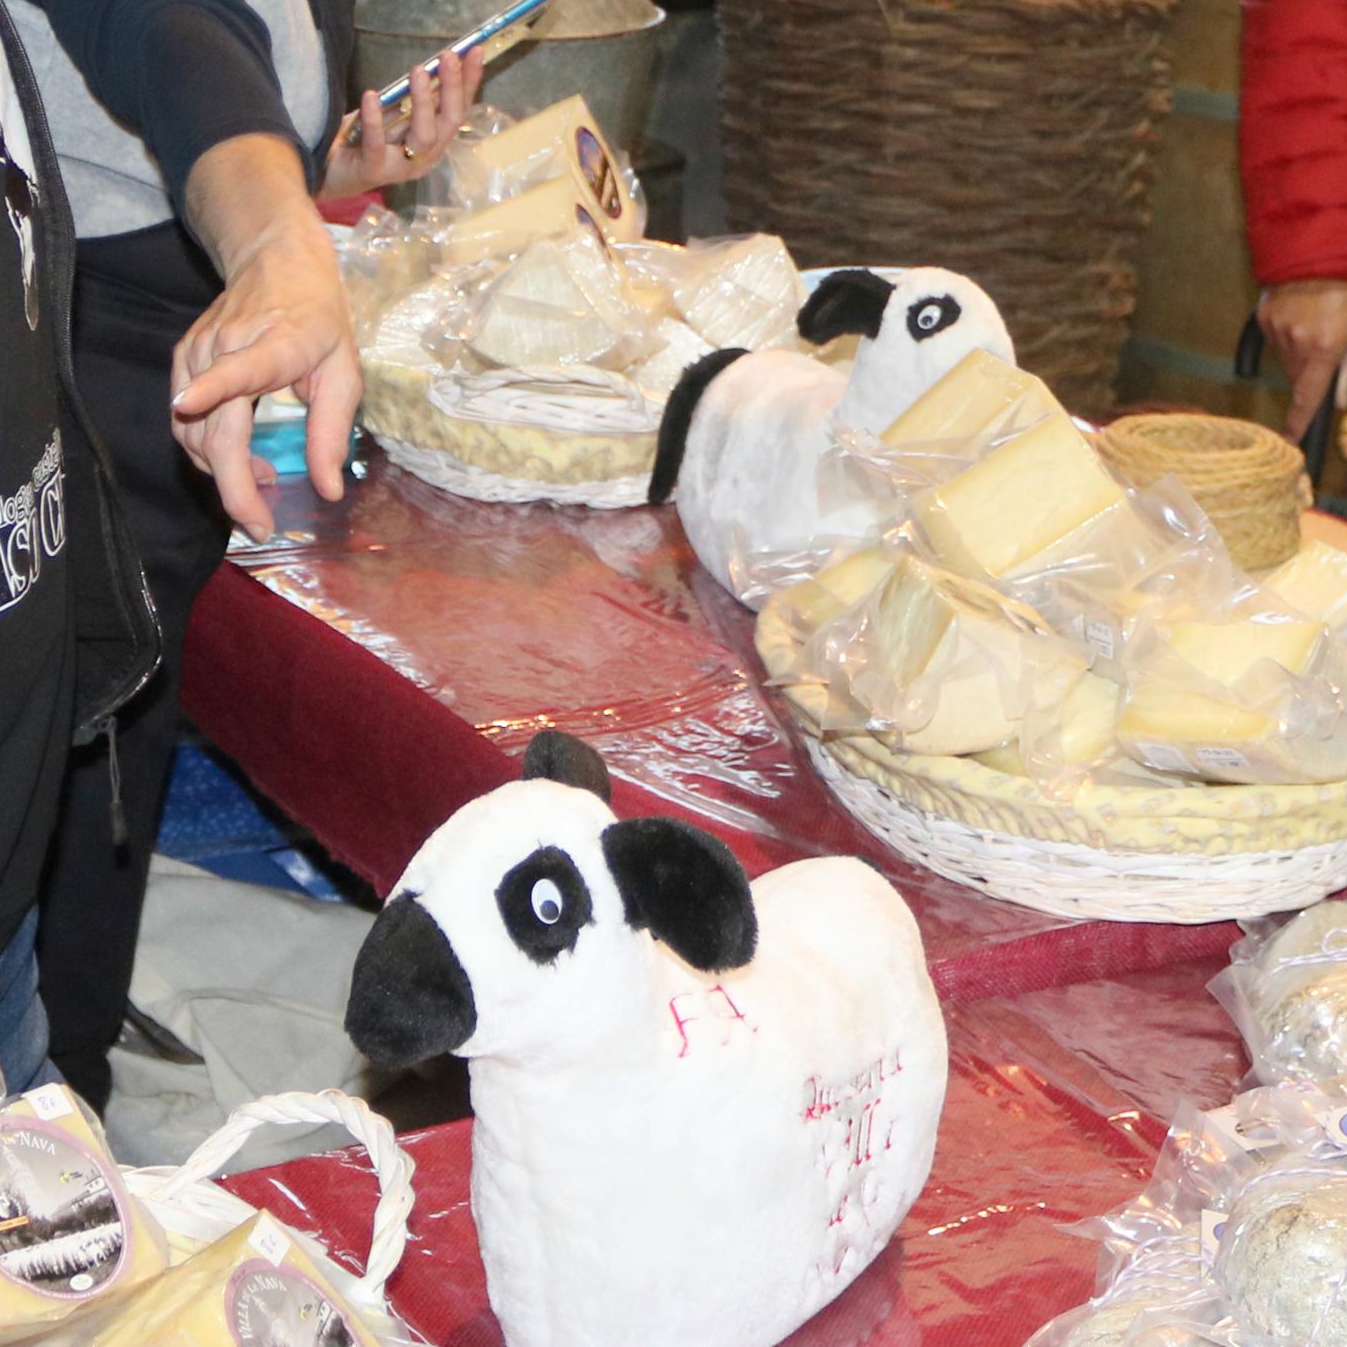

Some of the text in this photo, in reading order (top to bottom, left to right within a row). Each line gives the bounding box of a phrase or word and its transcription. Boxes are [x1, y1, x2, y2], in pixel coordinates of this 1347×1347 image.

[19, 1131, 57, 1156] NAVA
[237, 1301, 253, 1339] VILLA
[254, 1275, 287, 1292] NAVA
